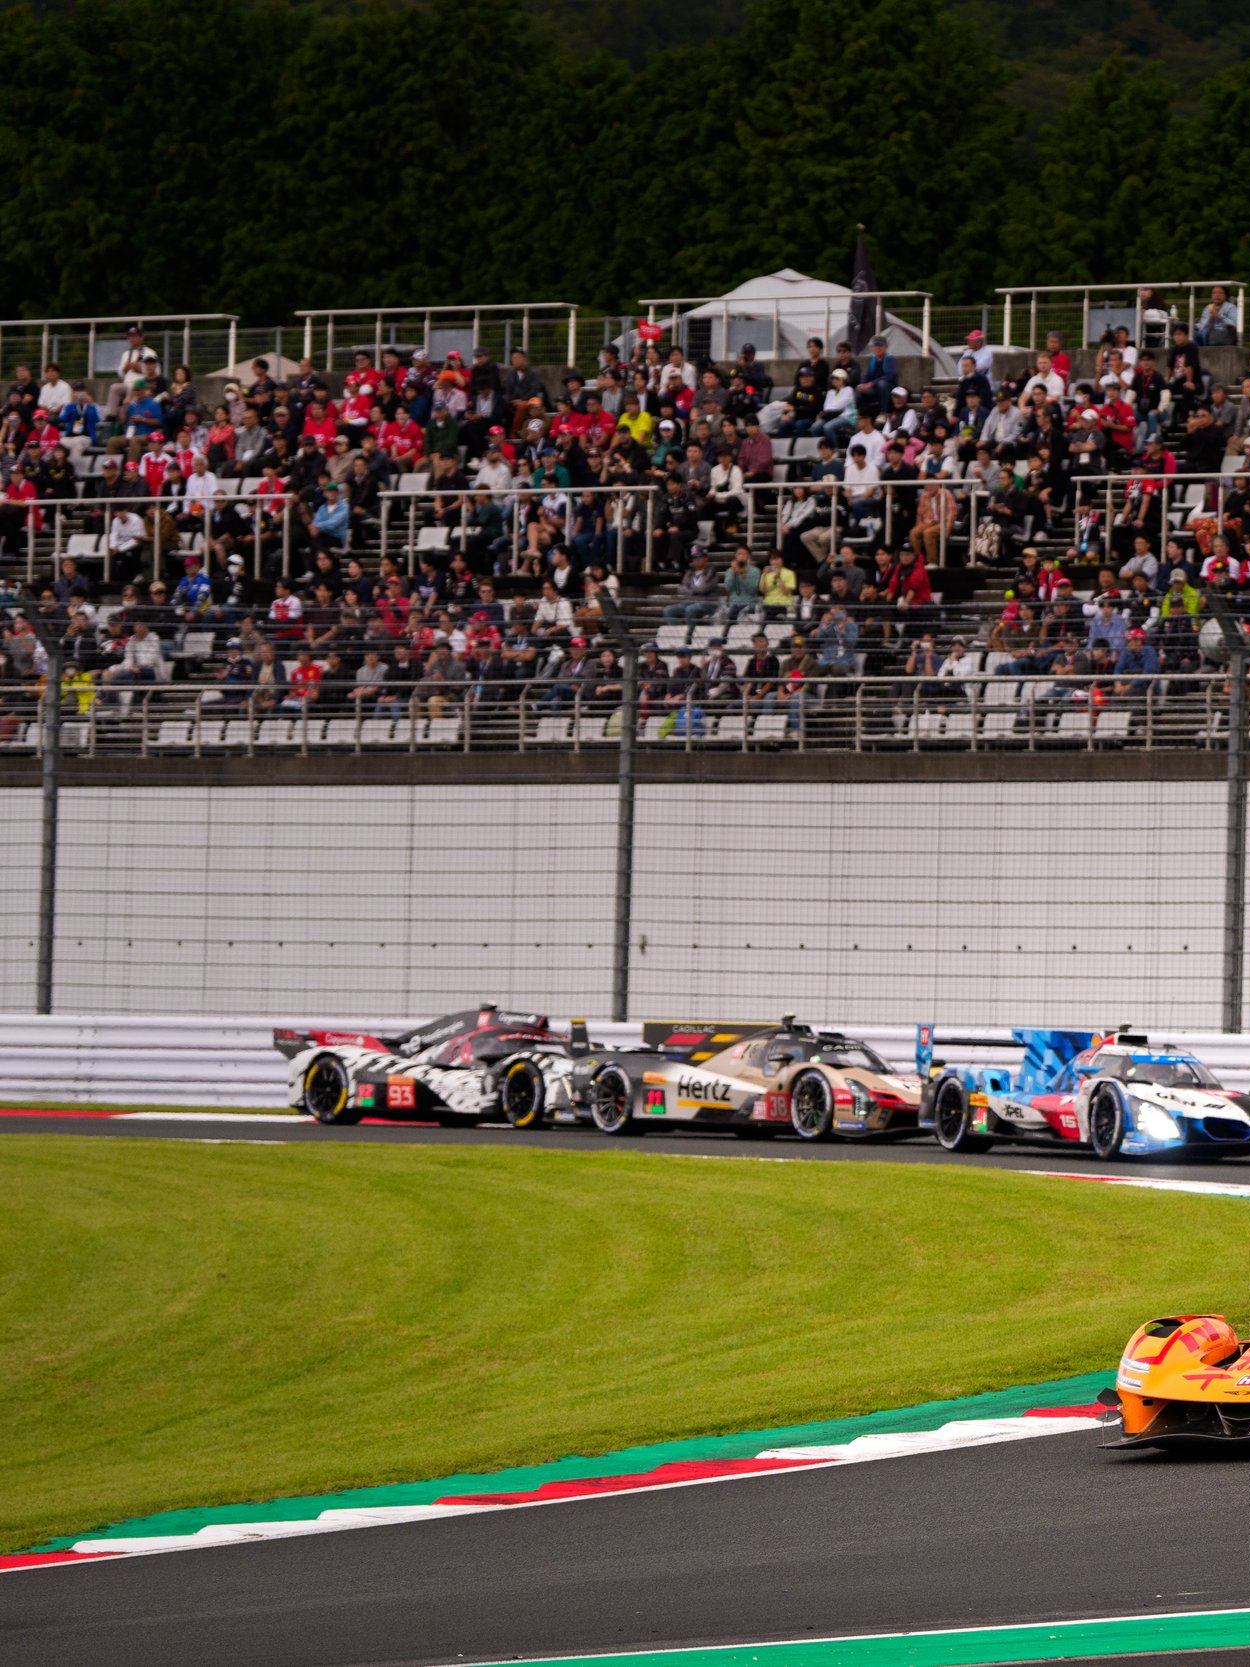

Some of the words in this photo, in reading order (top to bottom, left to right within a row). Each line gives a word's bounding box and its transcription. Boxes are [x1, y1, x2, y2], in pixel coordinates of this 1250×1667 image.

[672, 1025, 716, 1033] CADILLAC
[388, 1085, 413, 1105] 93
[677, 1074, 732, 1102] Hertz
[647, 1090, 663, 1106] 11
[770, 1096, 787, 1117] 38
[1059, 1114, 1077, 1129] 15
